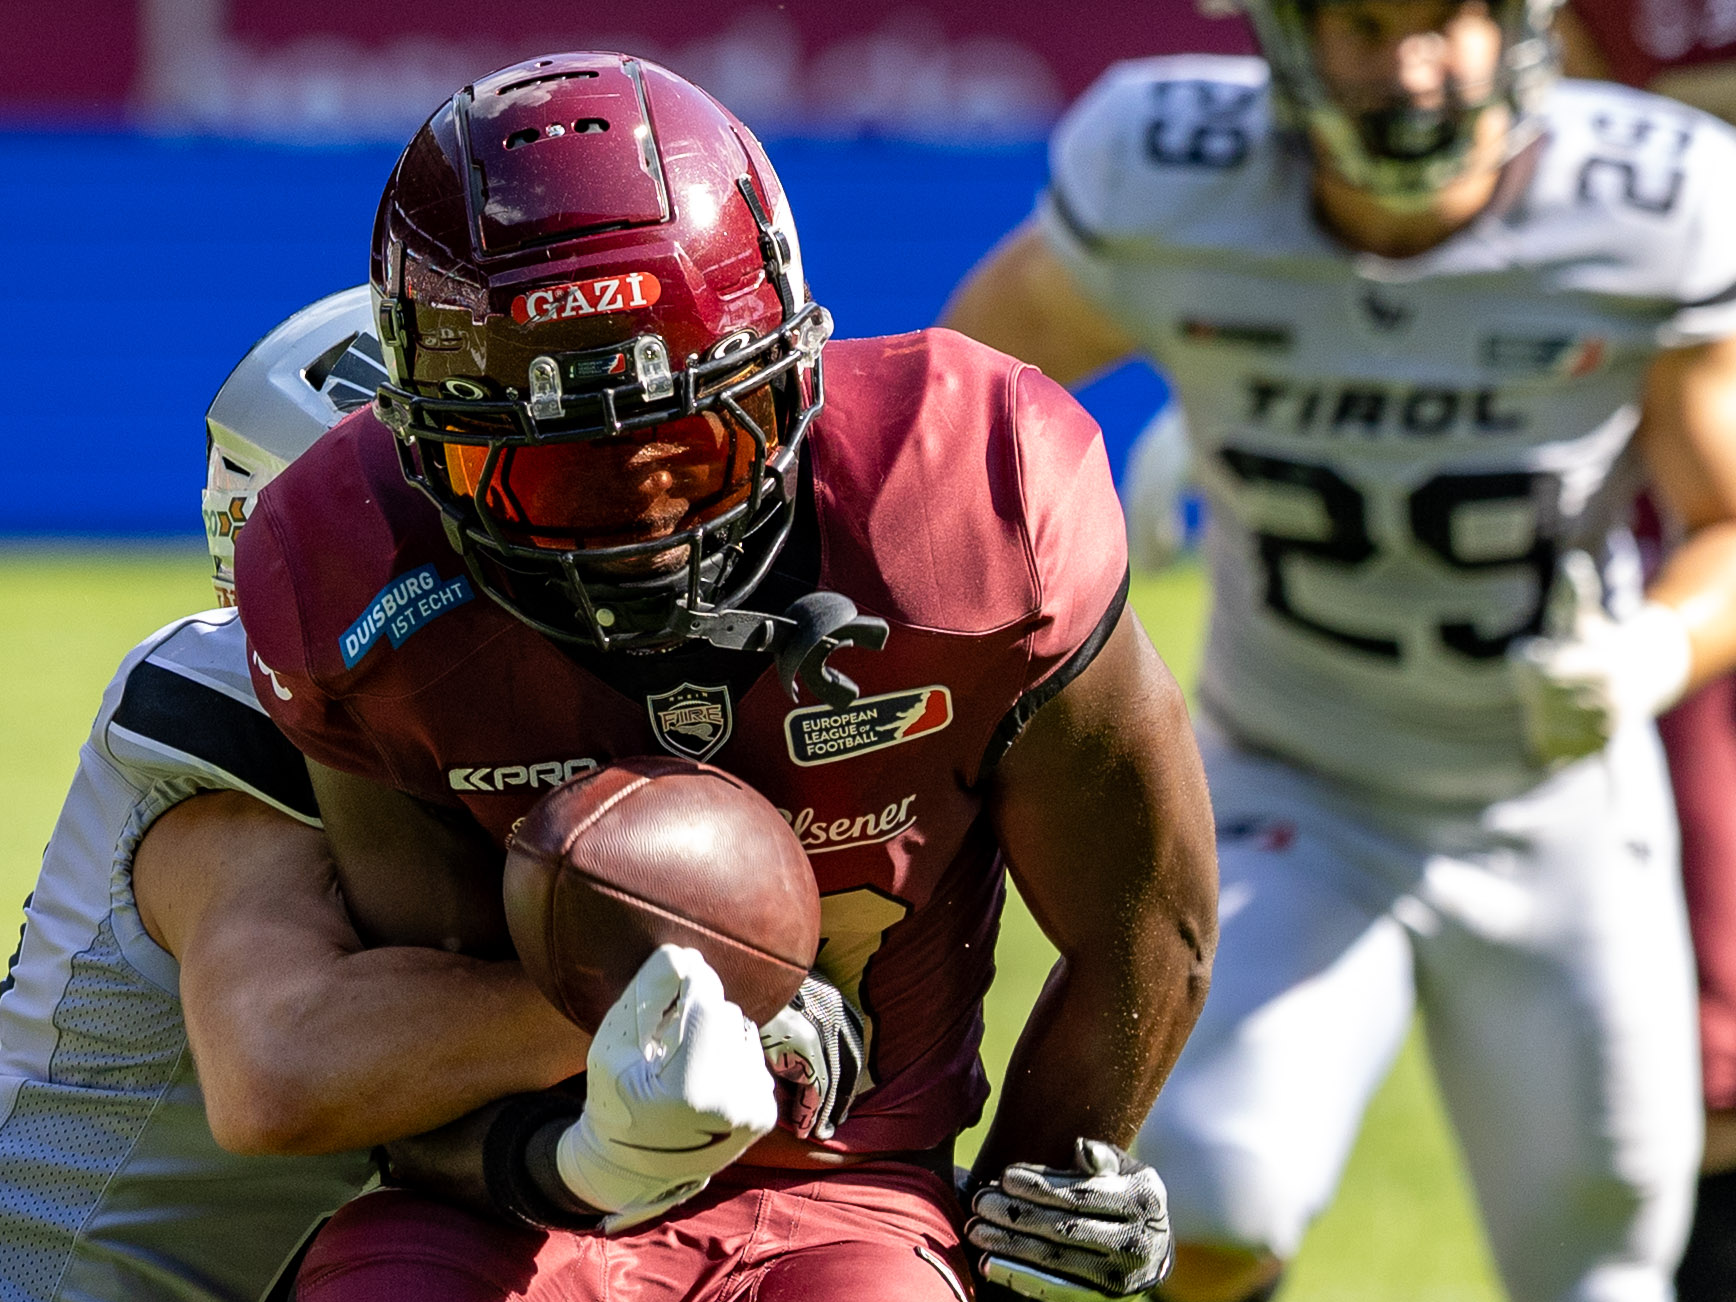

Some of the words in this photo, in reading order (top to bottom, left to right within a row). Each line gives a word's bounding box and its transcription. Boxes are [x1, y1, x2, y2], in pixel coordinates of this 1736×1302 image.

[1248, 380, 1527, 436] TIROL
[1220, 446, 1558, 660] 29
[345, 571, 434, 659] DUISBURG
[391, 607, 416, 639] IST
[417, 582, 463, 617] ECHT
[657, 704, 724, 733] FIRE
[802, 708, 878, 732] EUROPEAN
[804, 725, 858, 745] LEAGUE
[806, 731, 879, 757] FOOTBALL
[777, 793, 917, 847] lsener
